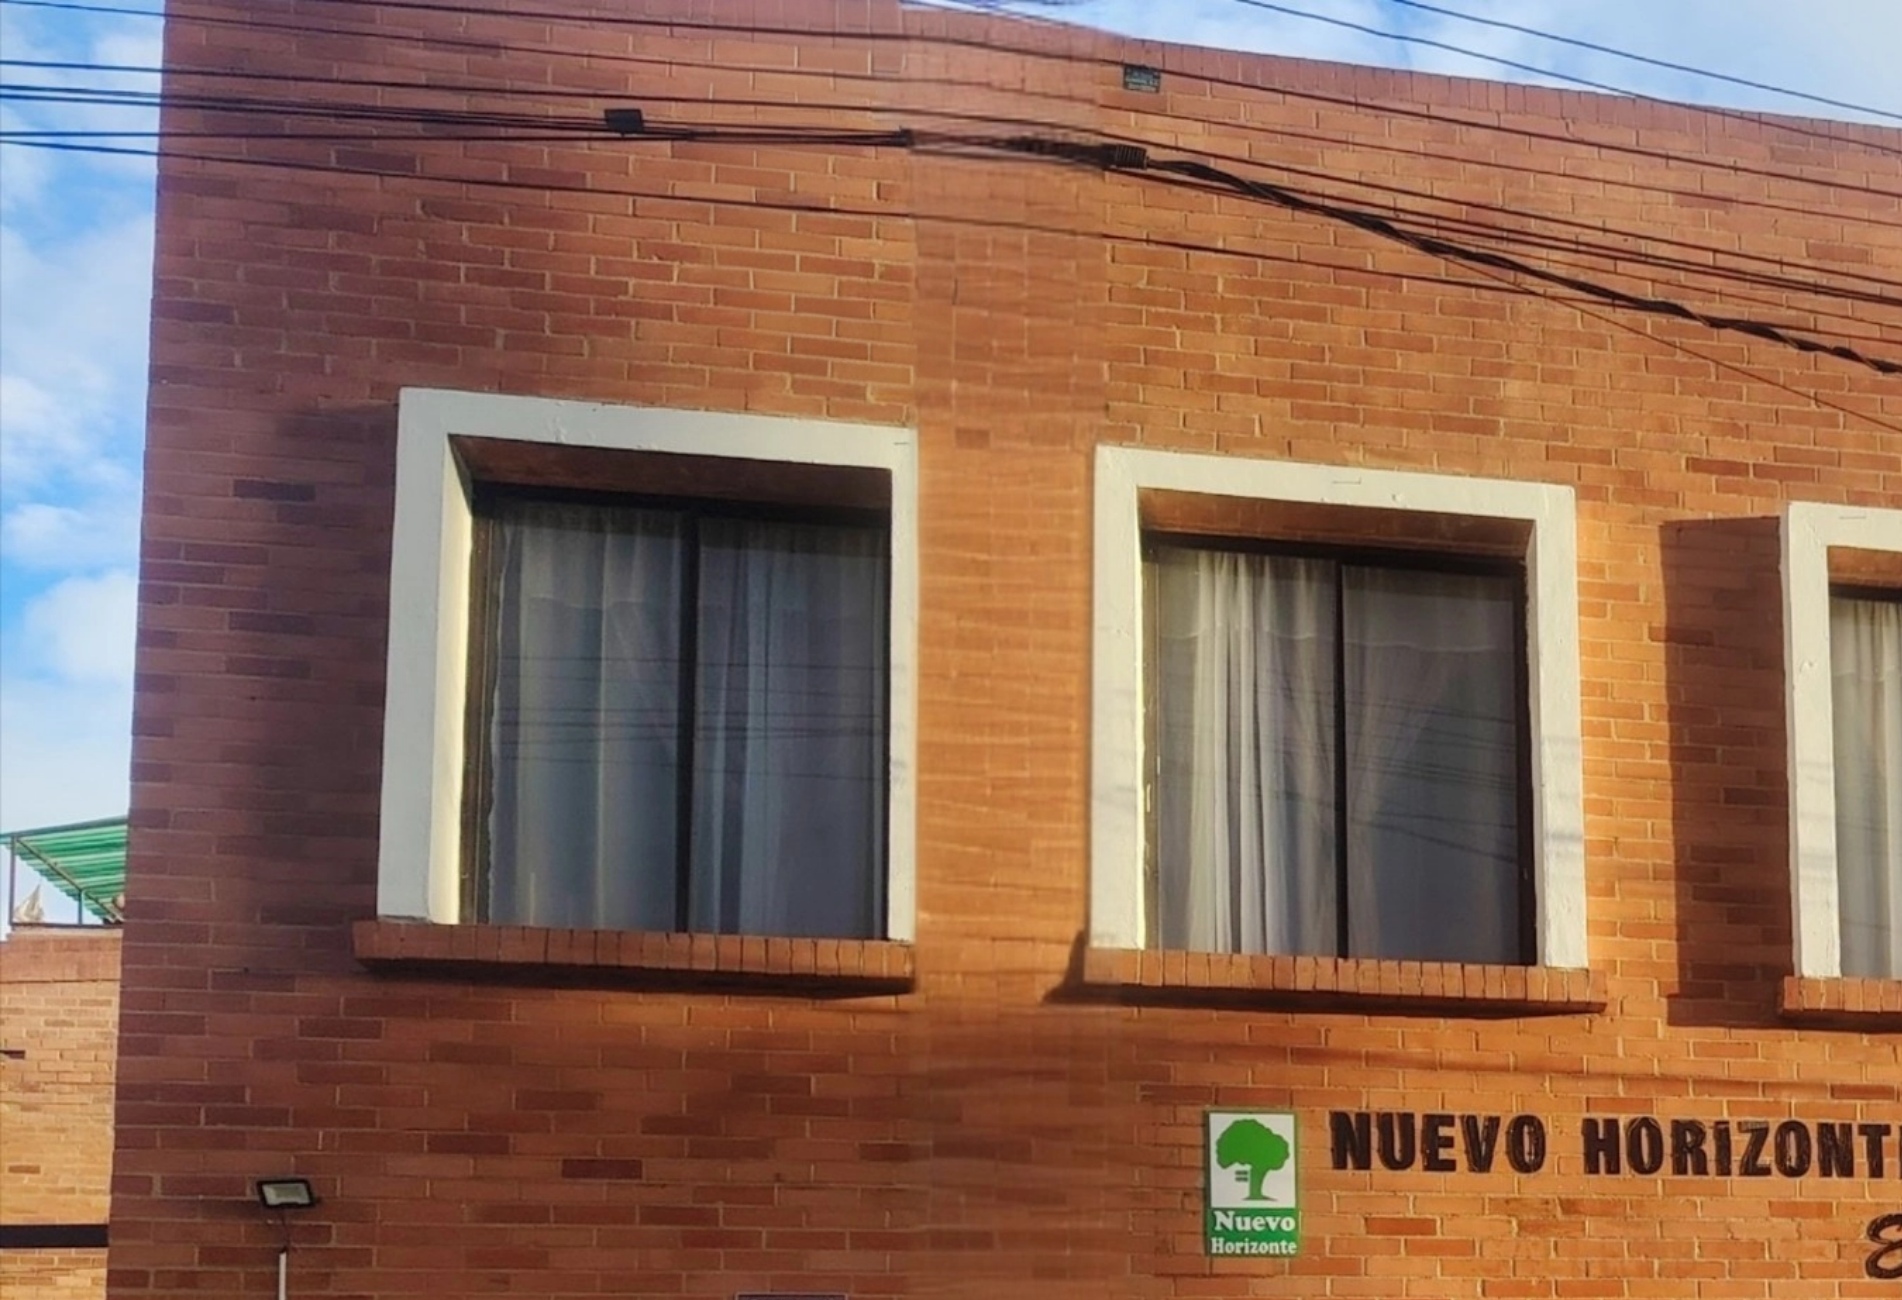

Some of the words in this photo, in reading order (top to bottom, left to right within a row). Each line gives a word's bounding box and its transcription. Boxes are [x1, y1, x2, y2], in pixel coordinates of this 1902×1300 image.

[1329, 1111, 1546, 1174] NUEVO
[1214, 1210, 1295, 1231] Nuevo
[1211, 1238, 1297, 1254] Horizonte
